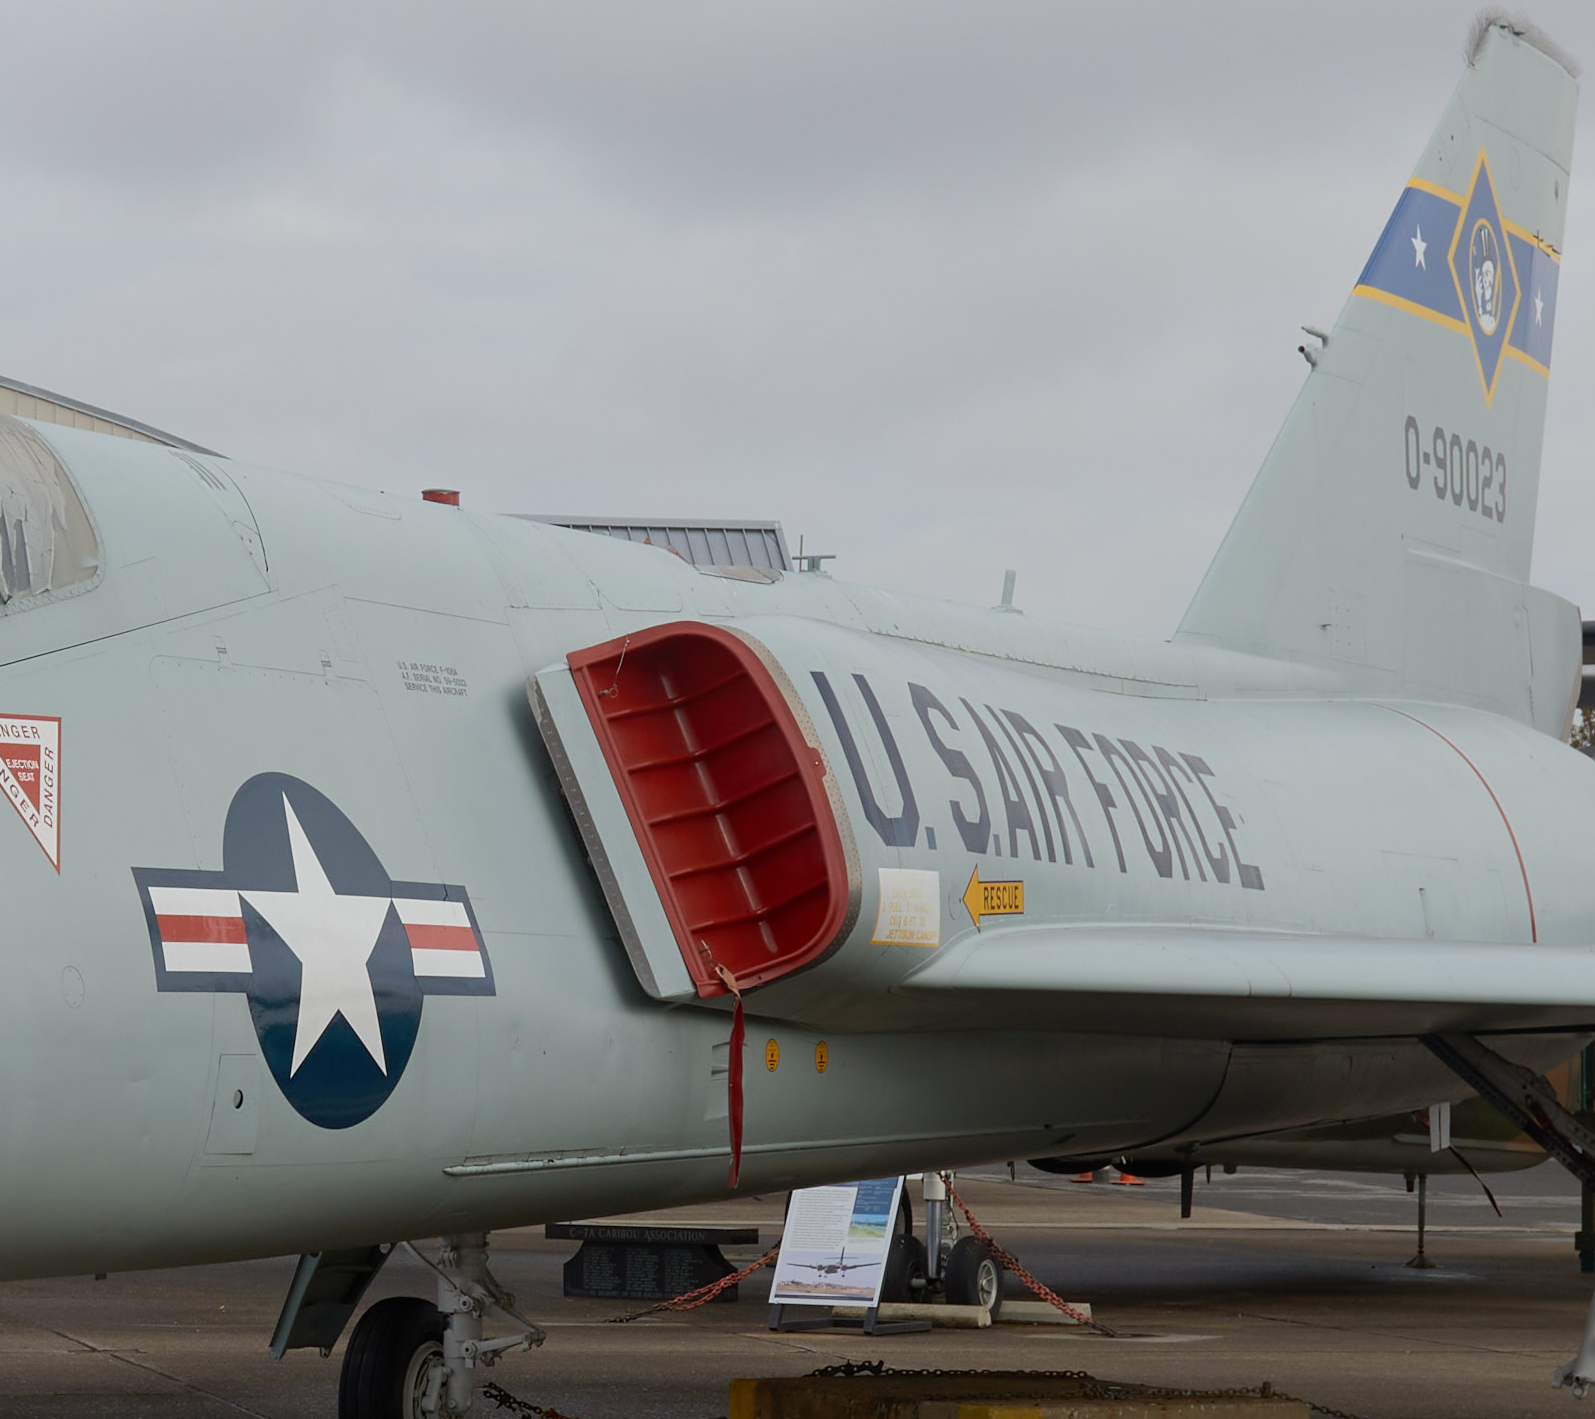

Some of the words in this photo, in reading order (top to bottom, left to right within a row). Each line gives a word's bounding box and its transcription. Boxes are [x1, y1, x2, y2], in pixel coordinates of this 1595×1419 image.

[1404, 414, 1507, 524] 0-90023
[5, 758, 40, 769] EJECTION
[17, 771, 35, 782] SEAT
[43, 746, 54, 828] DANGER
[958, 696, 1096, 869] AIR
[1053, 723, 1266, 892] FORCE
[983, 885, 1019, 910] RESCUE
[598, 1228, 639, 1239] CARIBOU
[642, 1230, 705, 1242] ASSOCIATION
